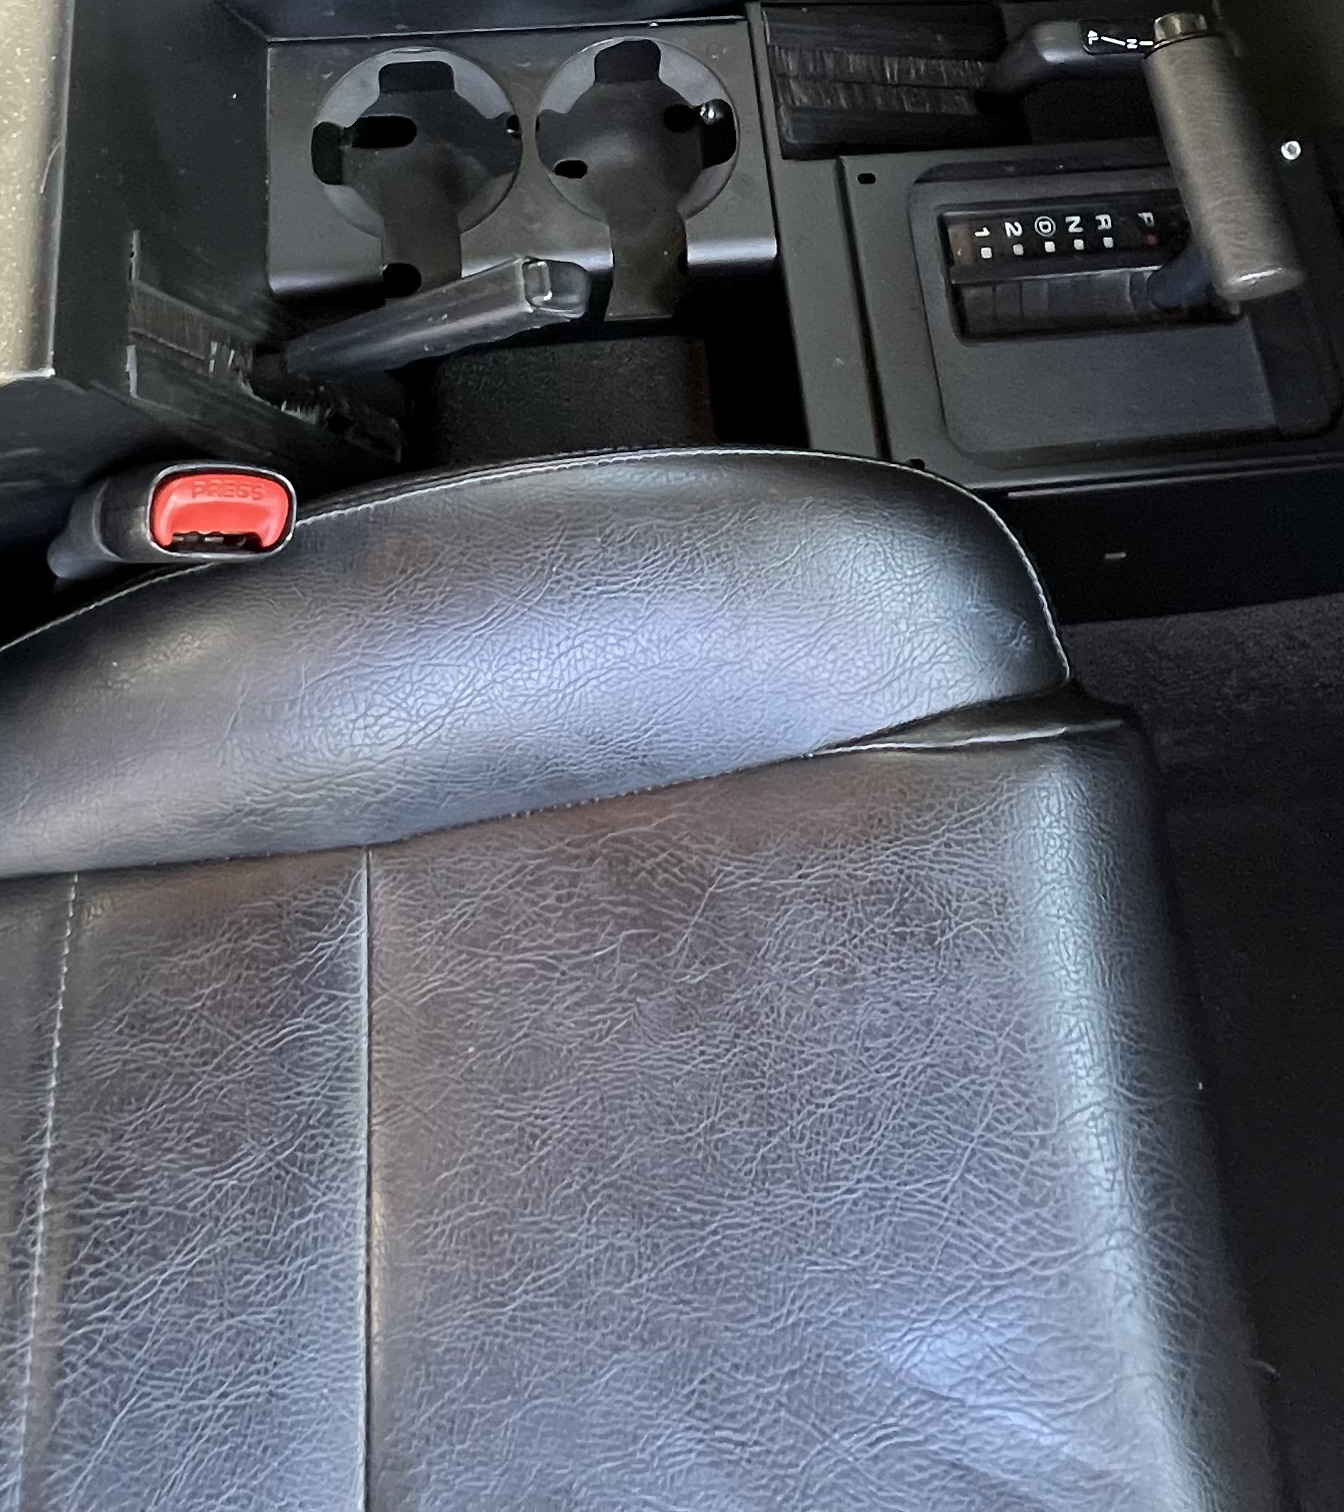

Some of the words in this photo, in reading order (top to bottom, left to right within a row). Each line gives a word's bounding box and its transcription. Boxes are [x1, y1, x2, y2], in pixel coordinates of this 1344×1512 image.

[1065, 215, 1084, 233] N
[1095, 213, 1112, 231] R
[1137, 211, 1155, 227] P
[974, 226, 990, 237] 1
[1005, 221, 1023, 238] 2
[191, 479, 266, 501] PRESS
